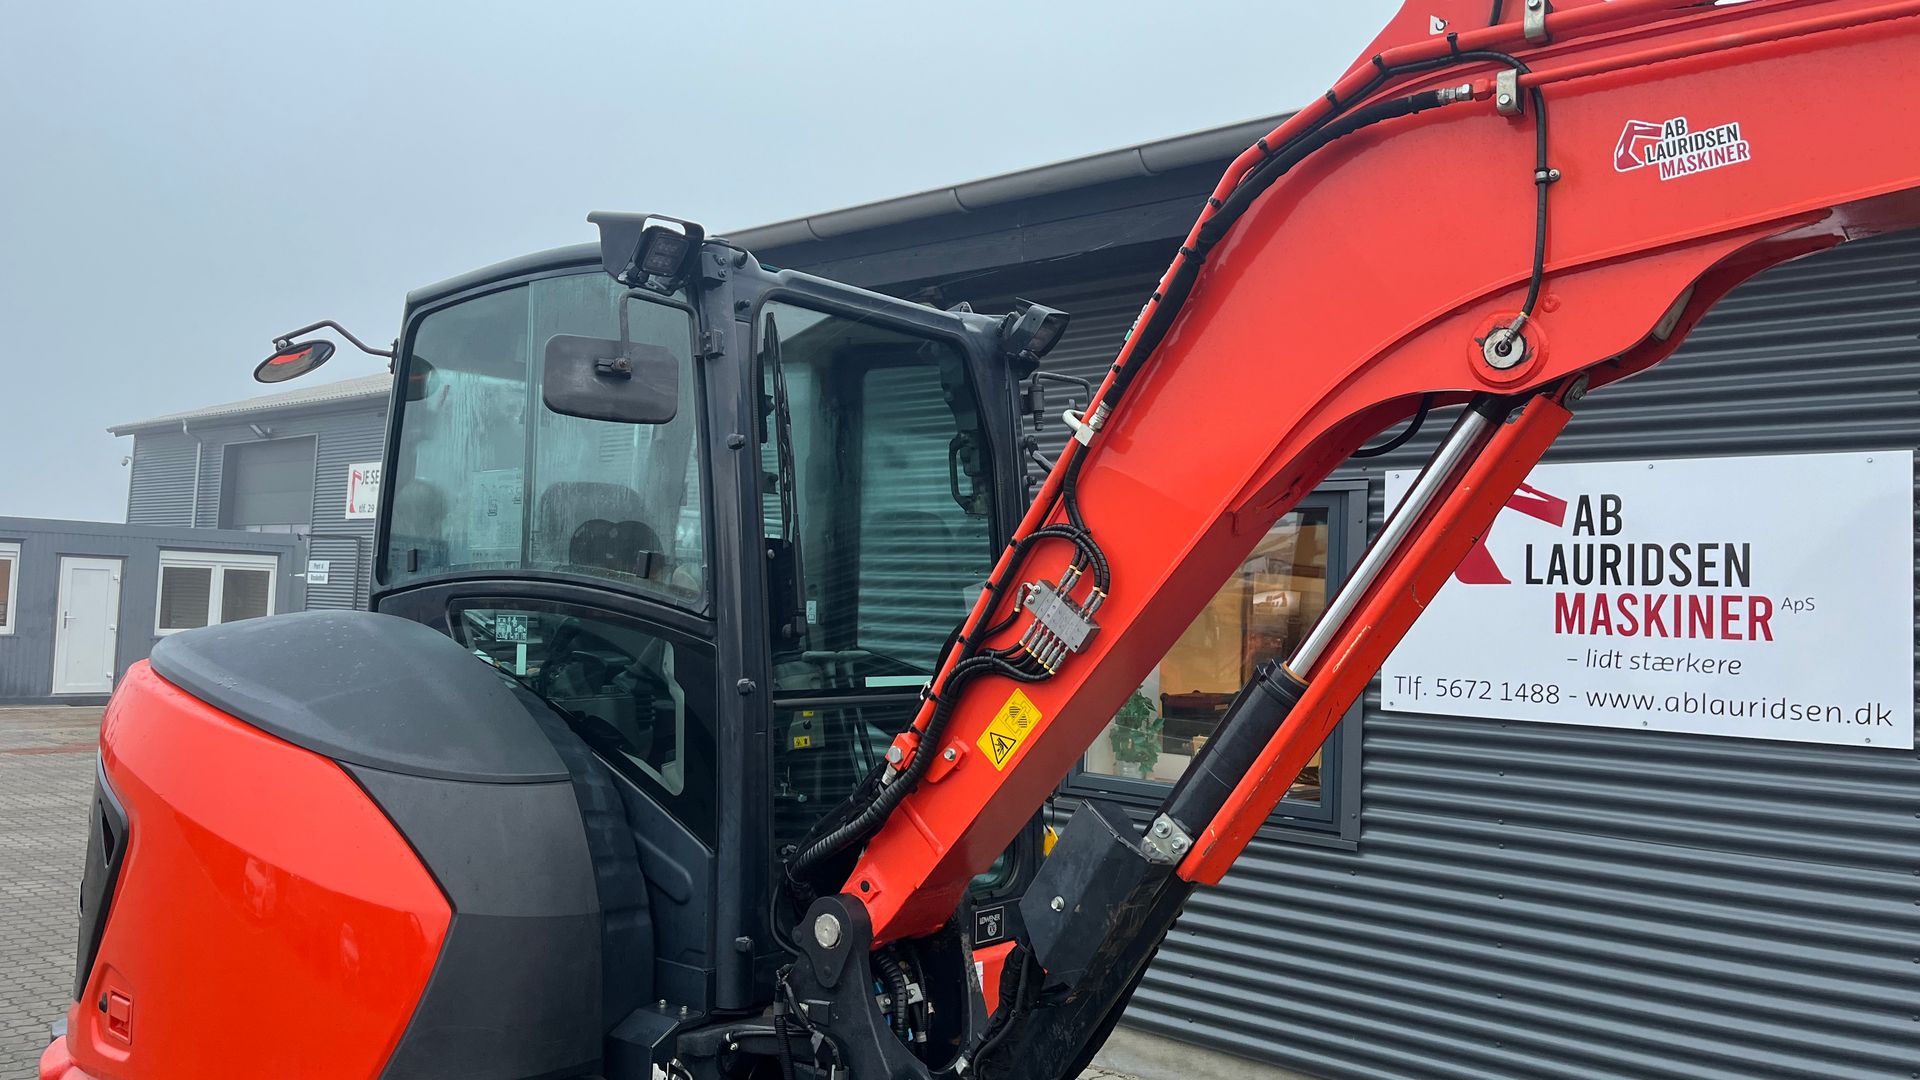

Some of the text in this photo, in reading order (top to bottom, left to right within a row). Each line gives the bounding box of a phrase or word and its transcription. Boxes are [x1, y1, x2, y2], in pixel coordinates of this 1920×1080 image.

[1646, 124, 1738, 163] LAURIDSEN
[1665, 118, 1686, 139] AB
[1661, 142, 1748, 179] MASKINER
[1572, 494, 1622, 536] AB
[1525, 542, 1751, 587] LAURIDSEN
[1554, 592, 1815, 642] MASKINER ApS
[1586, 648, 1622, 671] lidt
[1629, 654, 1742, 675] stærkere
[1394, 675, 1428, 700] Tlf.
[1436, 679, 1493, 700] 5672
[1500, 681, 1560, 705] 1488
[1585, 690, 1894, 728] www.ablauridsen.dk
